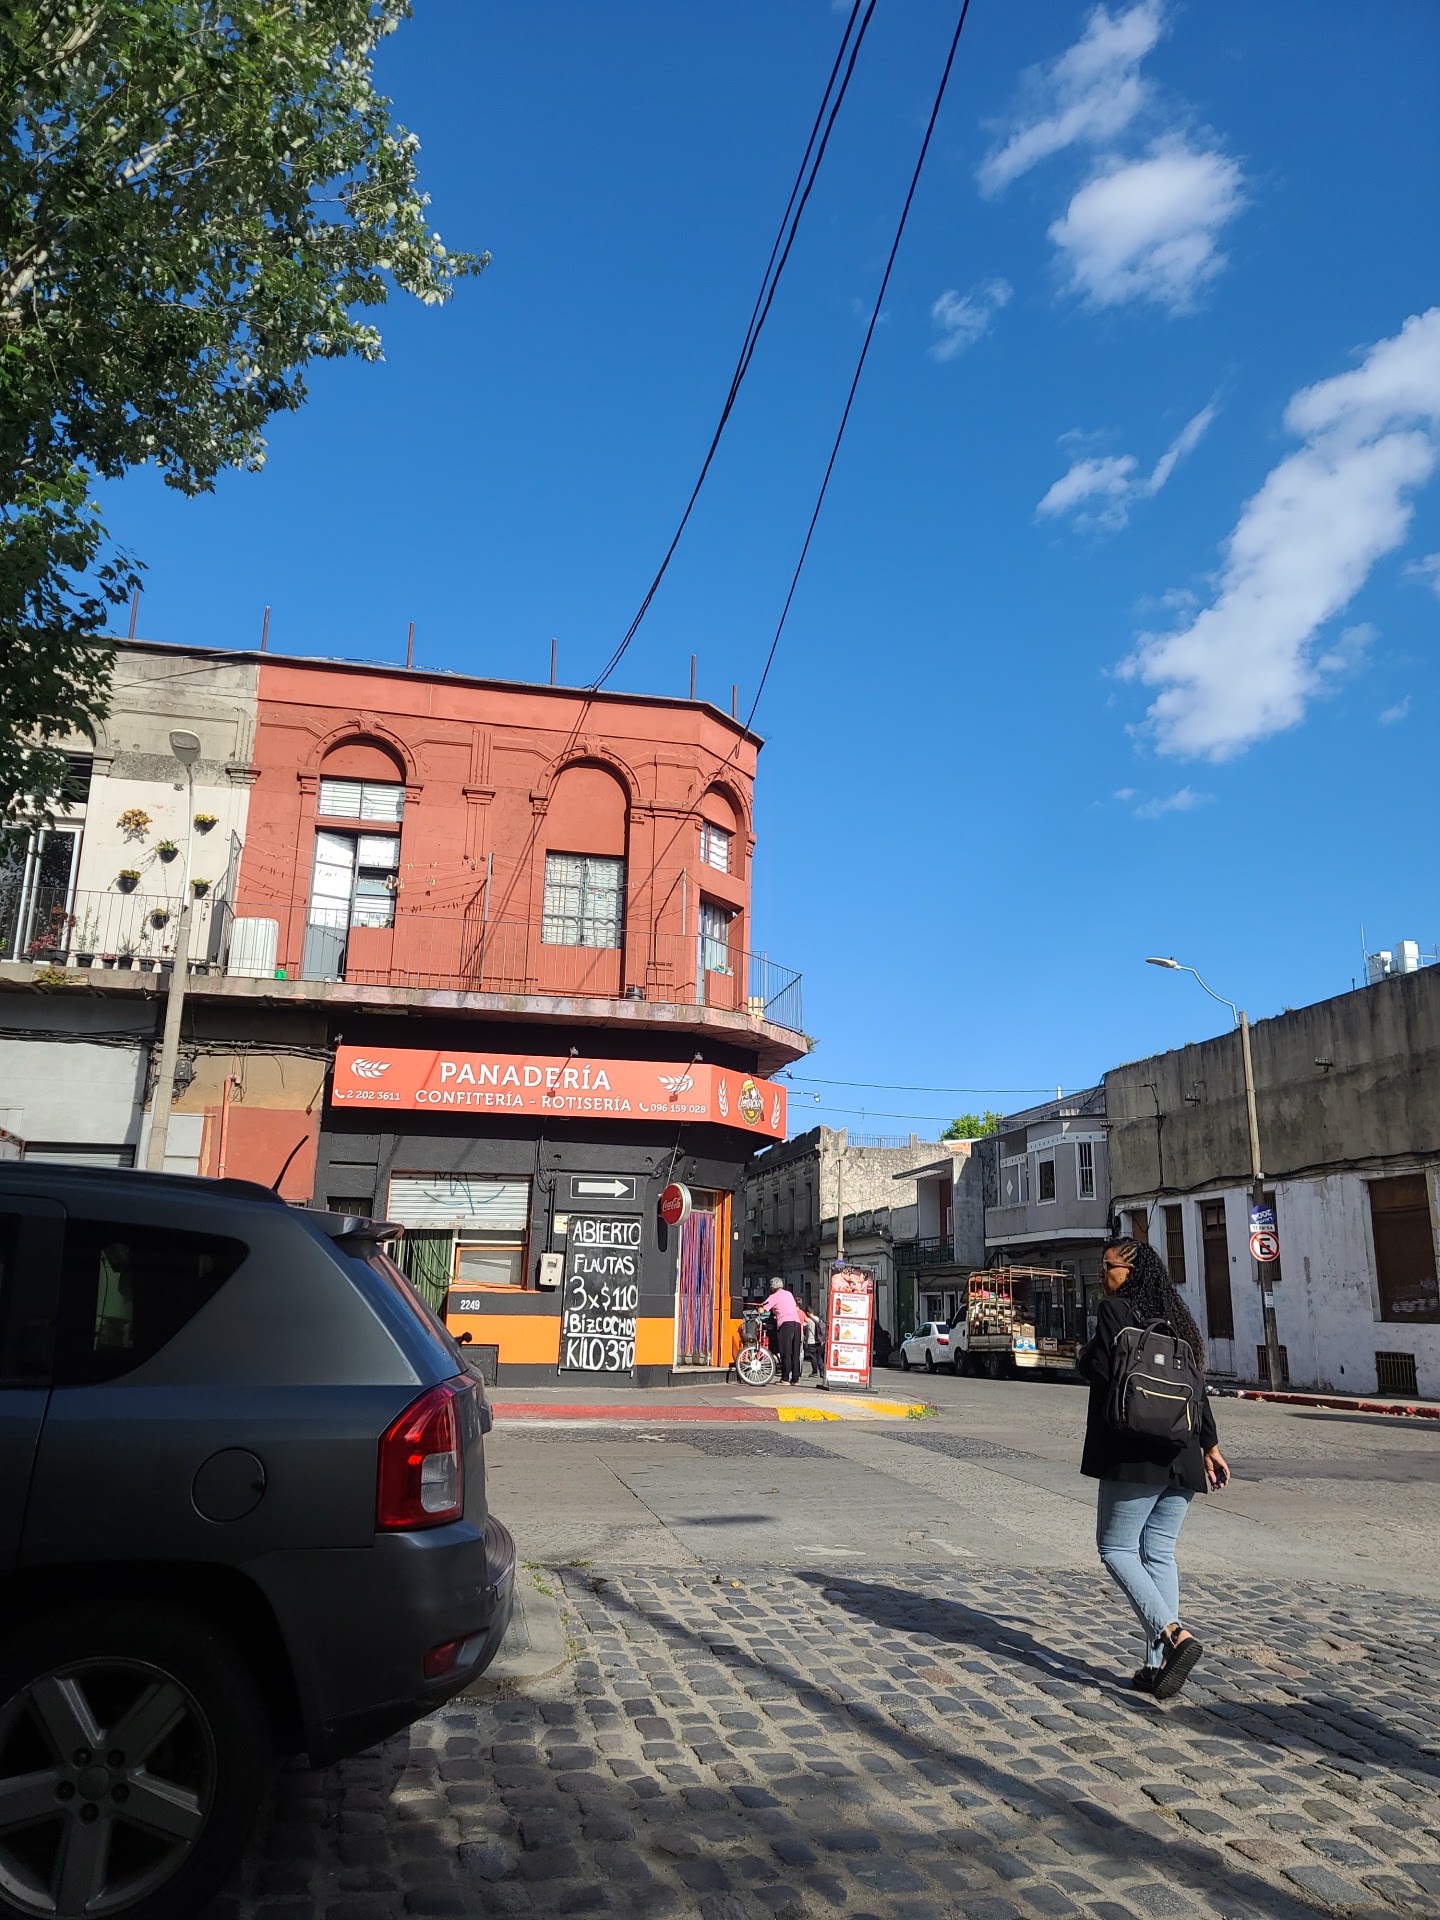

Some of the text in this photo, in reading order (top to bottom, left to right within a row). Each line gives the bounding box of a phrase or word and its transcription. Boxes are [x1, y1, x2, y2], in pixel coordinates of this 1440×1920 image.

[440, 1061, 611, 1091] PANADERÍA
[347, 1090, 401, 1101] 2 202 3611
[415, 1089, 524, 1107] CONFITERÍA
[541, 1095, 632, 1112] ROTISERÍA
[650, 1103, 706, 1114] 096 159 028
[572, 1220, 642, 1245] ABIERTO
[574, 1253, 635, 1275] FLAUTAS
[460, 1299, 480, 1311] 2249
